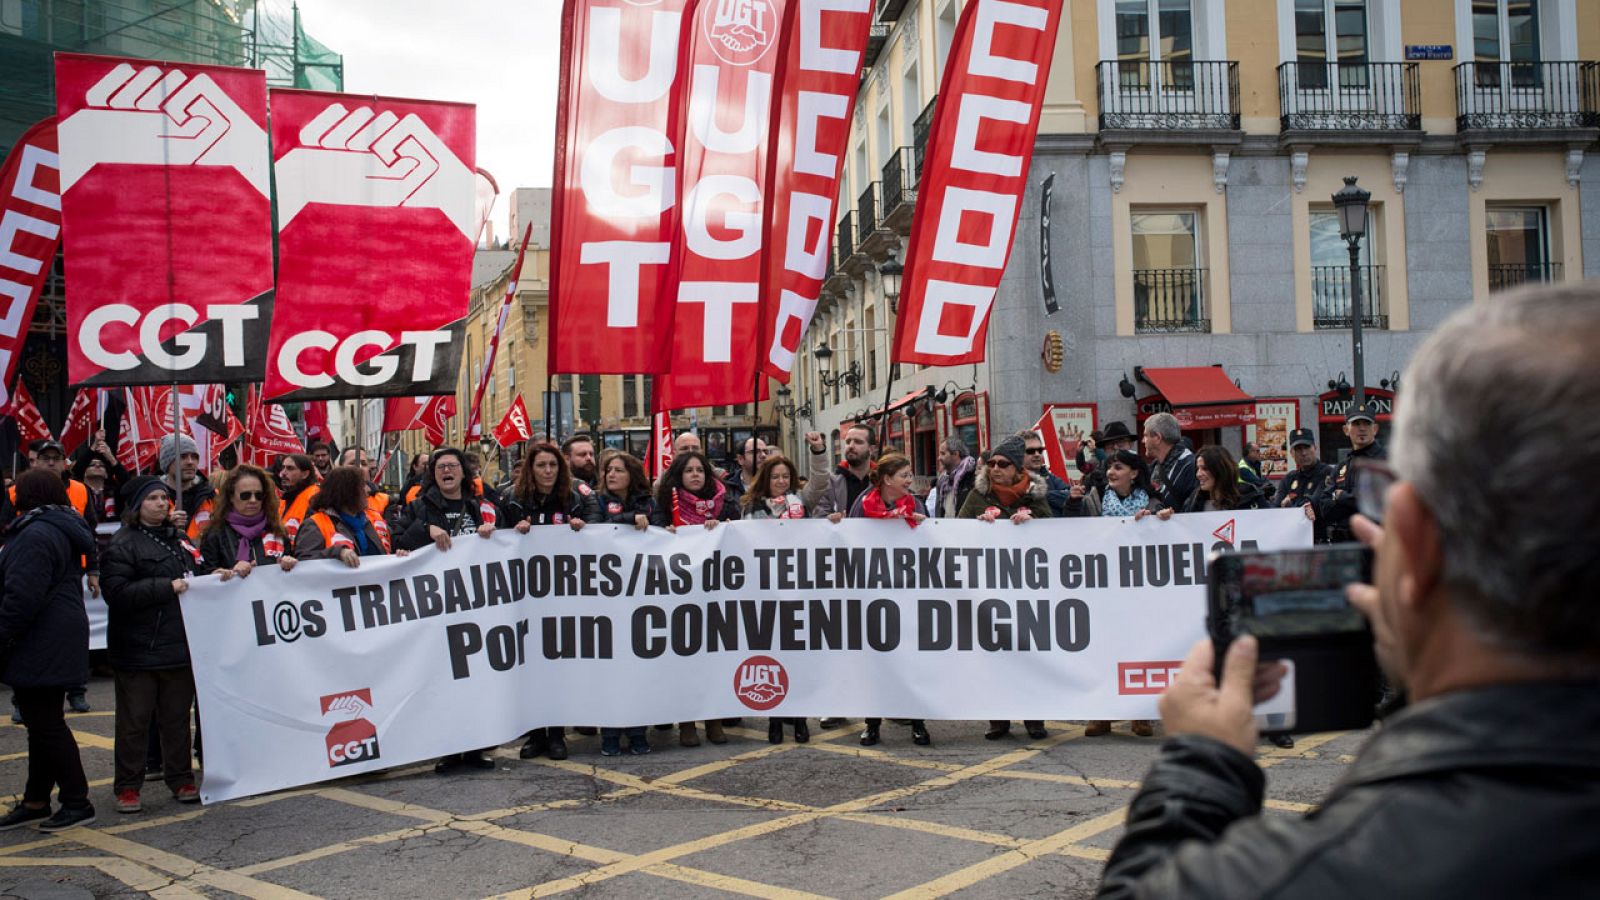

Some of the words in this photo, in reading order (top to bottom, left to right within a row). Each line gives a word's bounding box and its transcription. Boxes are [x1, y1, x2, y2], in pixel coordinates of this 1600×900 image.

[714, 0, 766, 32] UGT
[580, 7, 681, 327] UGT
[769, 0, 872, 372] CCOO
[914, 0, 1048, 356] CCOO
[677, 64, 771, 363] UGT
[0, 143, 61, 408] CCO
[78, 303, 259, 371] CGT
[276, 329, 452, 389] CGT
[269, 404, 289, 431] UG
[332, 552, 692, 633] TRABAJADORES/AS
[702, 550, 746, 591] de
[754, 547, 1048, 590] TELEMARKETING
[1060, 553, 1109, 589] en
[1119, 540, 1260, 587] HUEL
[446, 617, 530, 679] Por
[541, 614, 613, 660] un
[631, 599, 900, 659] CONVENIO
[917, 598, 1091, 652] DIGNO
[740, 665, 781, 687] UGT
[1124, 668, 1184, 688] CC
[329, 737, 376, 763] CGT
